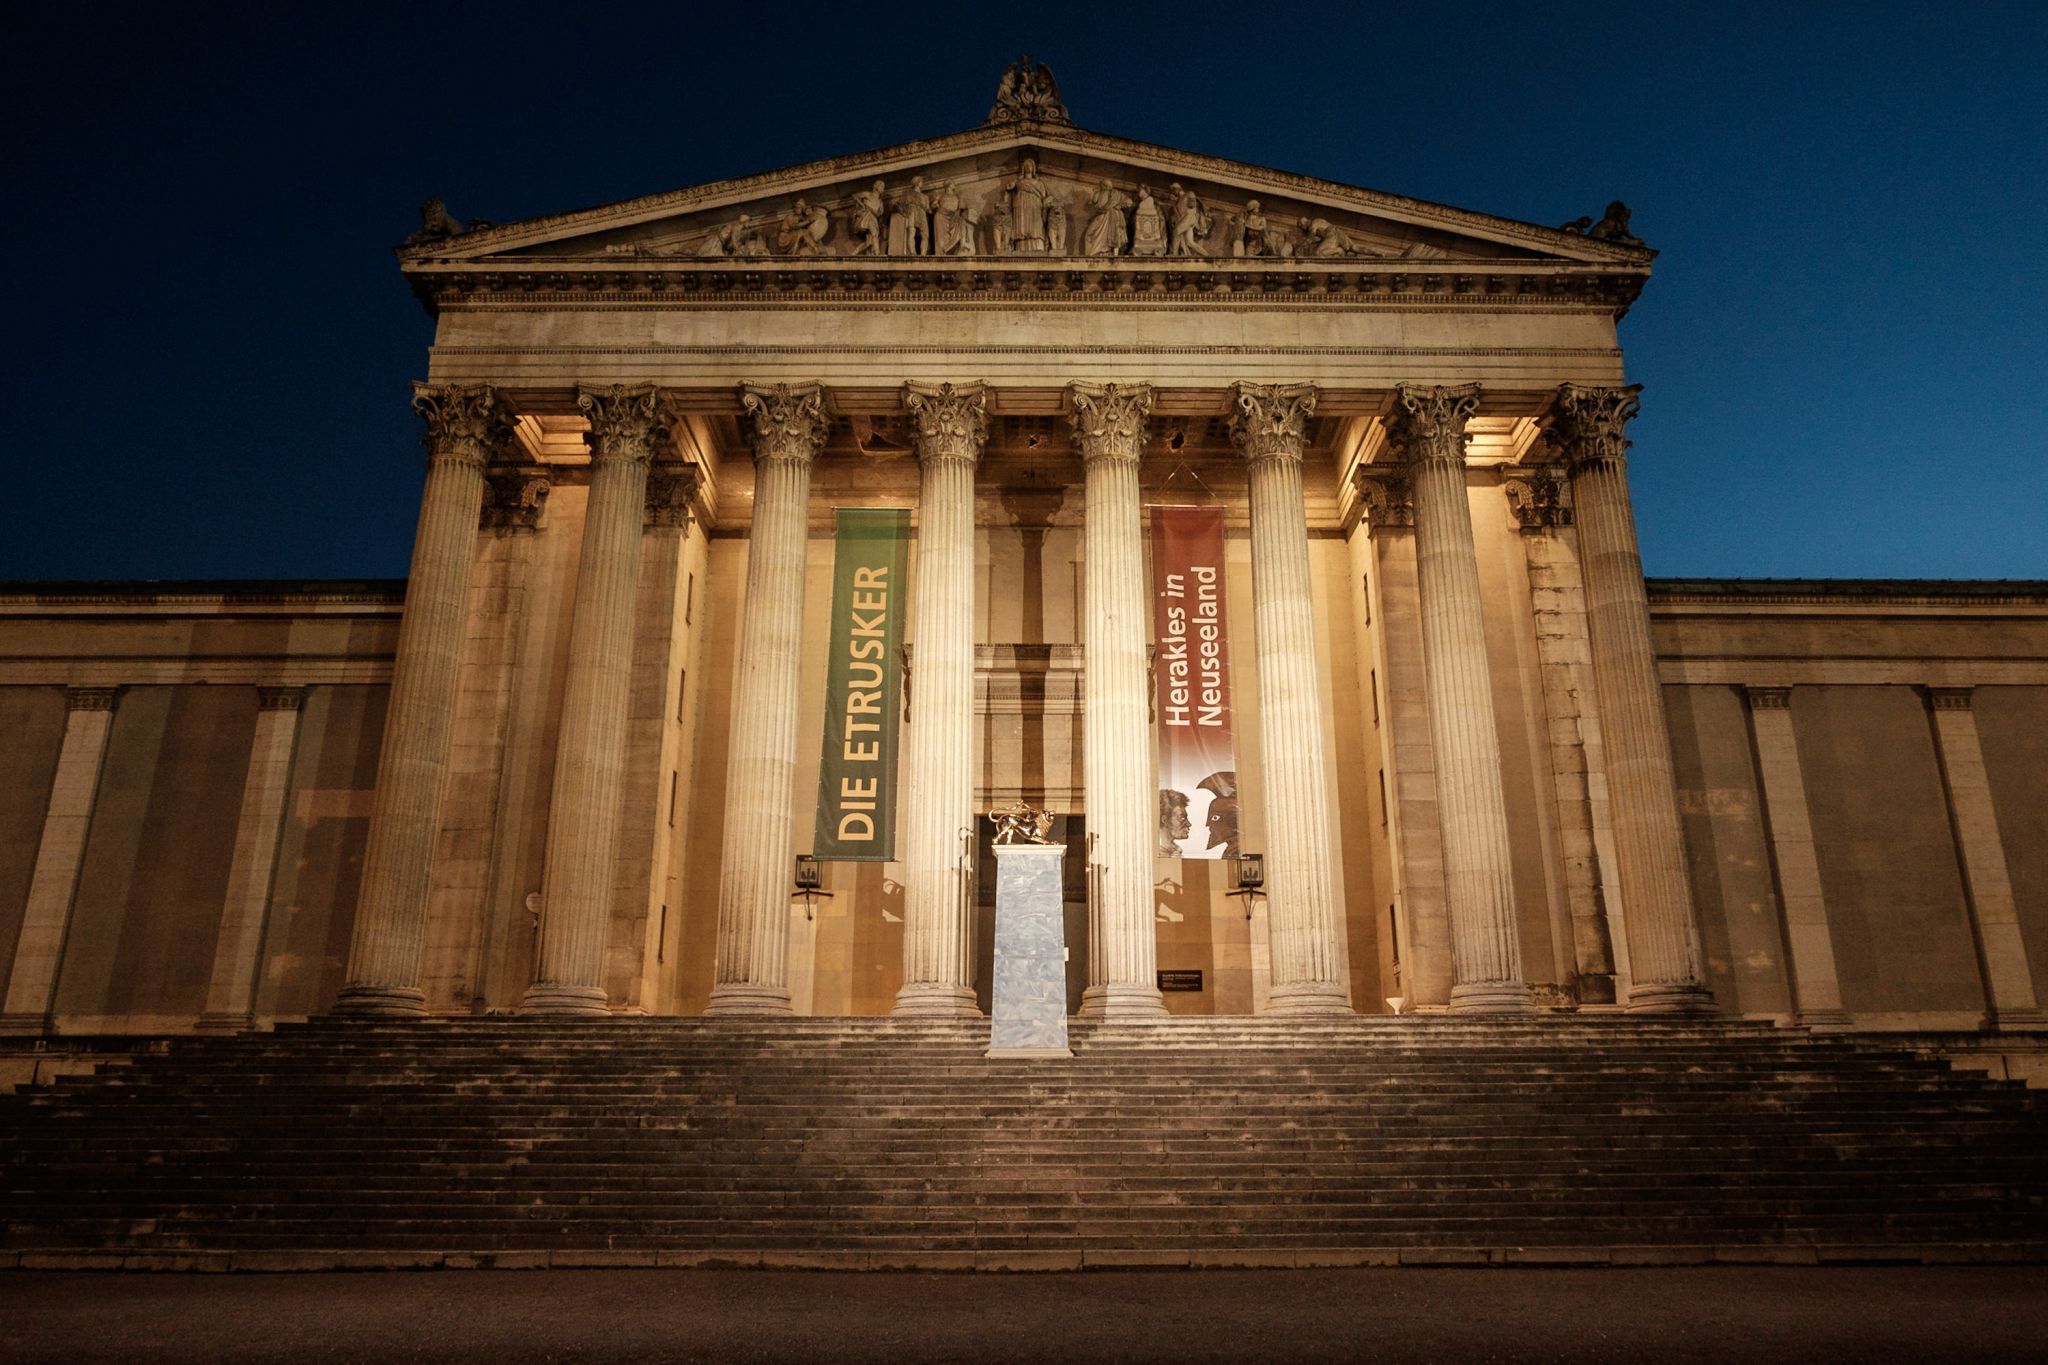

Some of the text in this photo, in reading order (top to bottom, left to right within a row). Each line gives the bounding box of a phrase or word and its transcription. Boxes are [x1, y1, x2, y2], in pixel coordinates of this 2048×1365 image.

[838, 566, 888, 841] DIE ETRUSKER
[1161, 573, 1190, 726] Herakles in
[1191, 566, 1223, 726] Neuseeland
